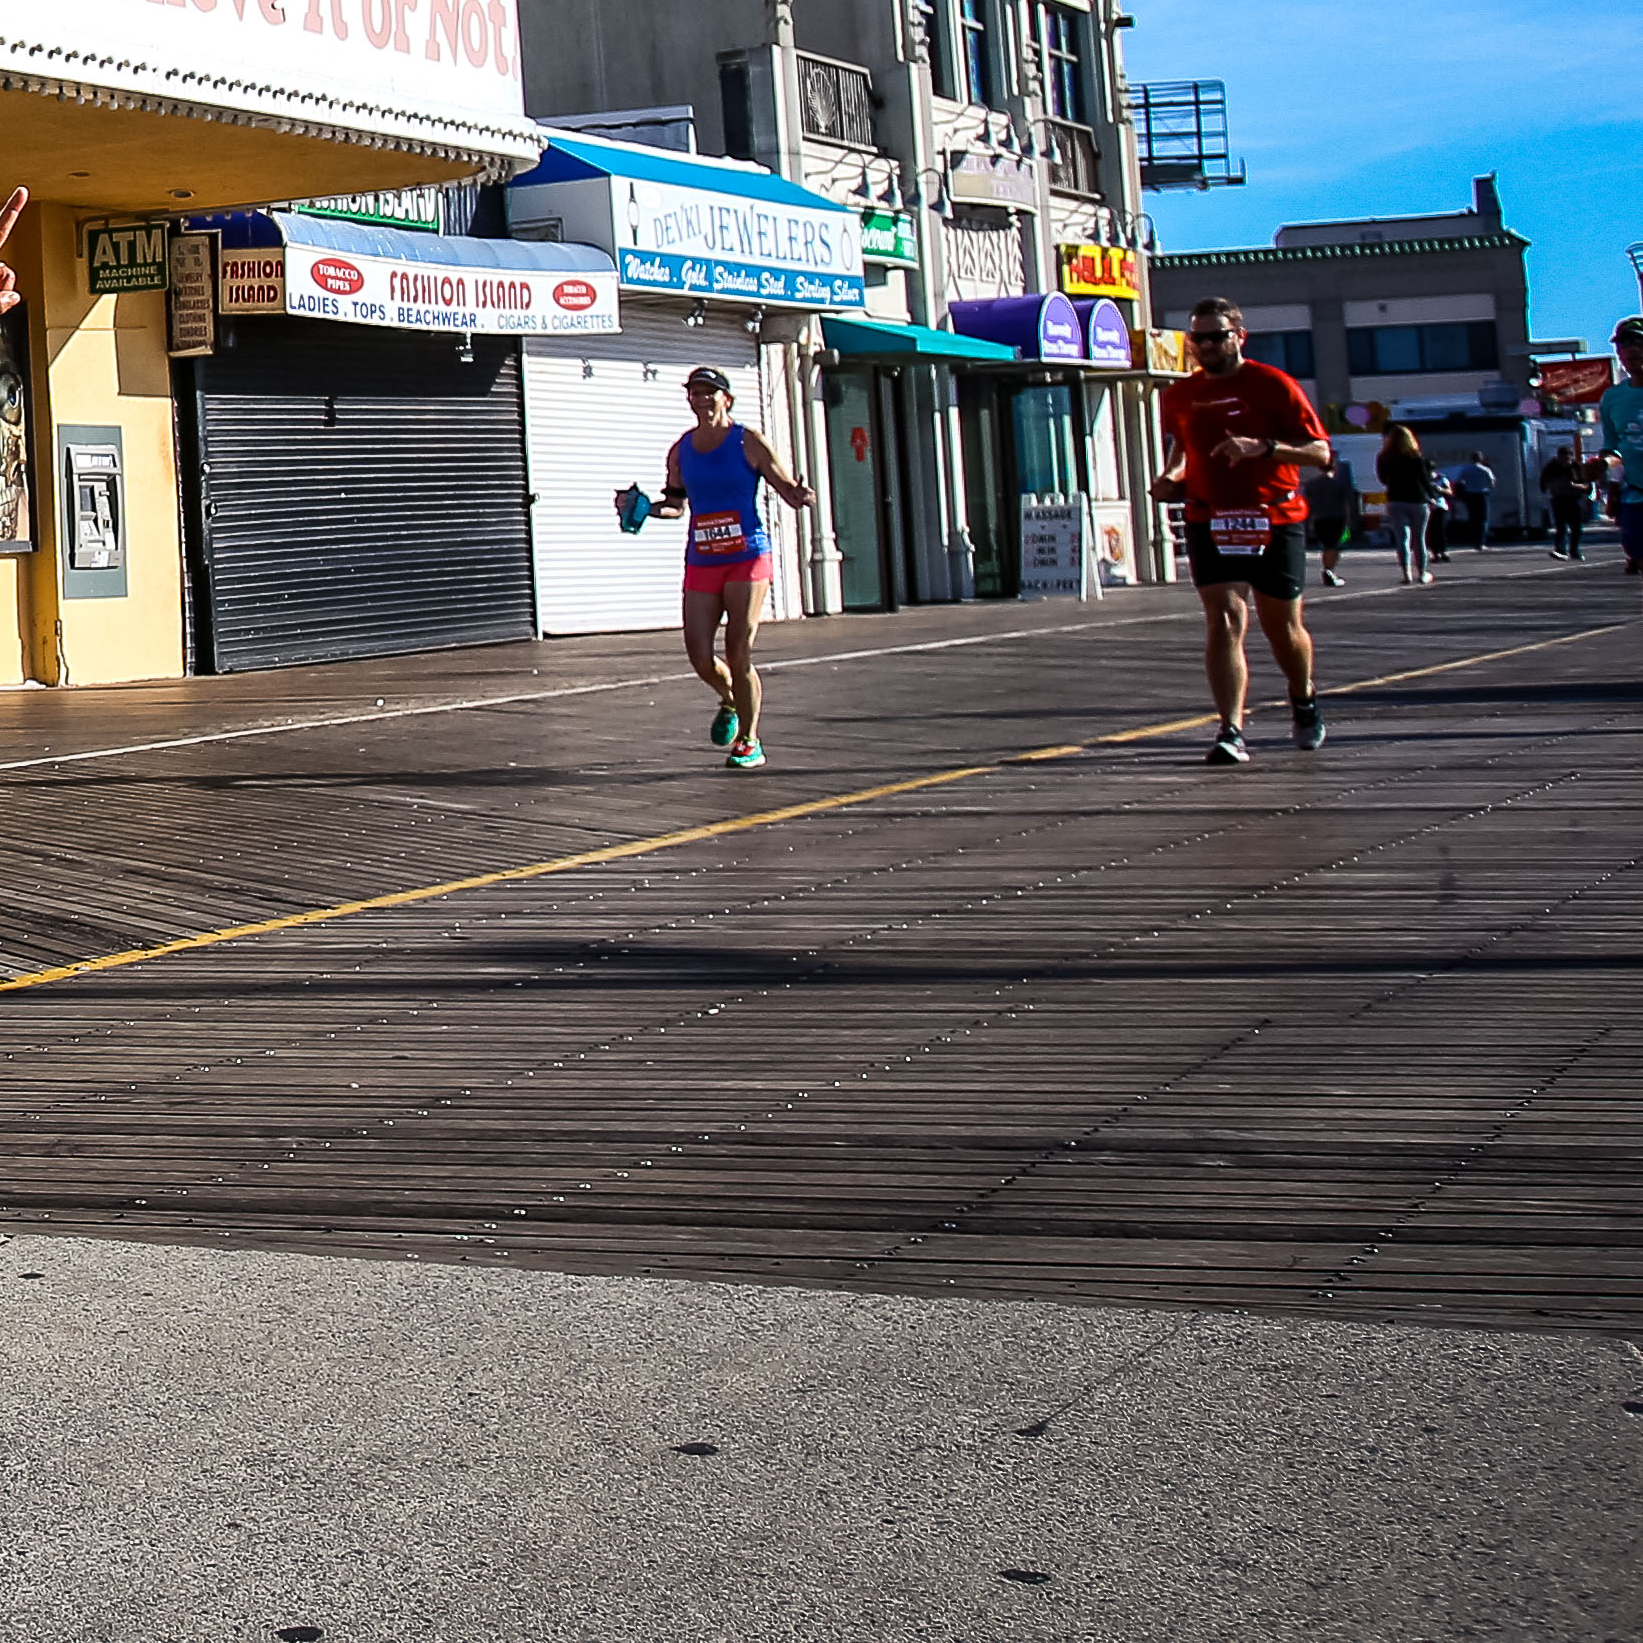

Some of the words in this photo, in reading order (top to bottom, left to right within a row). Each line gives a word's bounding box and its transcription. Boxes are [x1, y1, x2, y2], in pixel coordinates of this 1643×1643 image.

[93, 229, 163, 267] ATM
[704, 203, 832, 267] JEWELERS
[96, 276, 162, 289] AVAILABLE
[99, 265, 158, 278] MACHINE
[222, 260, 284, 279] FASHION
[625, 254, 670, 282] Watches
[760, 271, 785, 295] Steel
[229, 284, 278, 303] ISLAND
[390, 270, 466, 307] FASHION
[475, 278, 531, 310] ISLAND
[289, 292, 339, 316] LADIES
[353, 301, 386, 321] TOPS
[397, 307, 477, 328] BEACHWEAR
[498, 313, 536, 330] CIGARS
[541, 315, 548, 330] &
[551, 313, 614, 331] CIGARETTES
